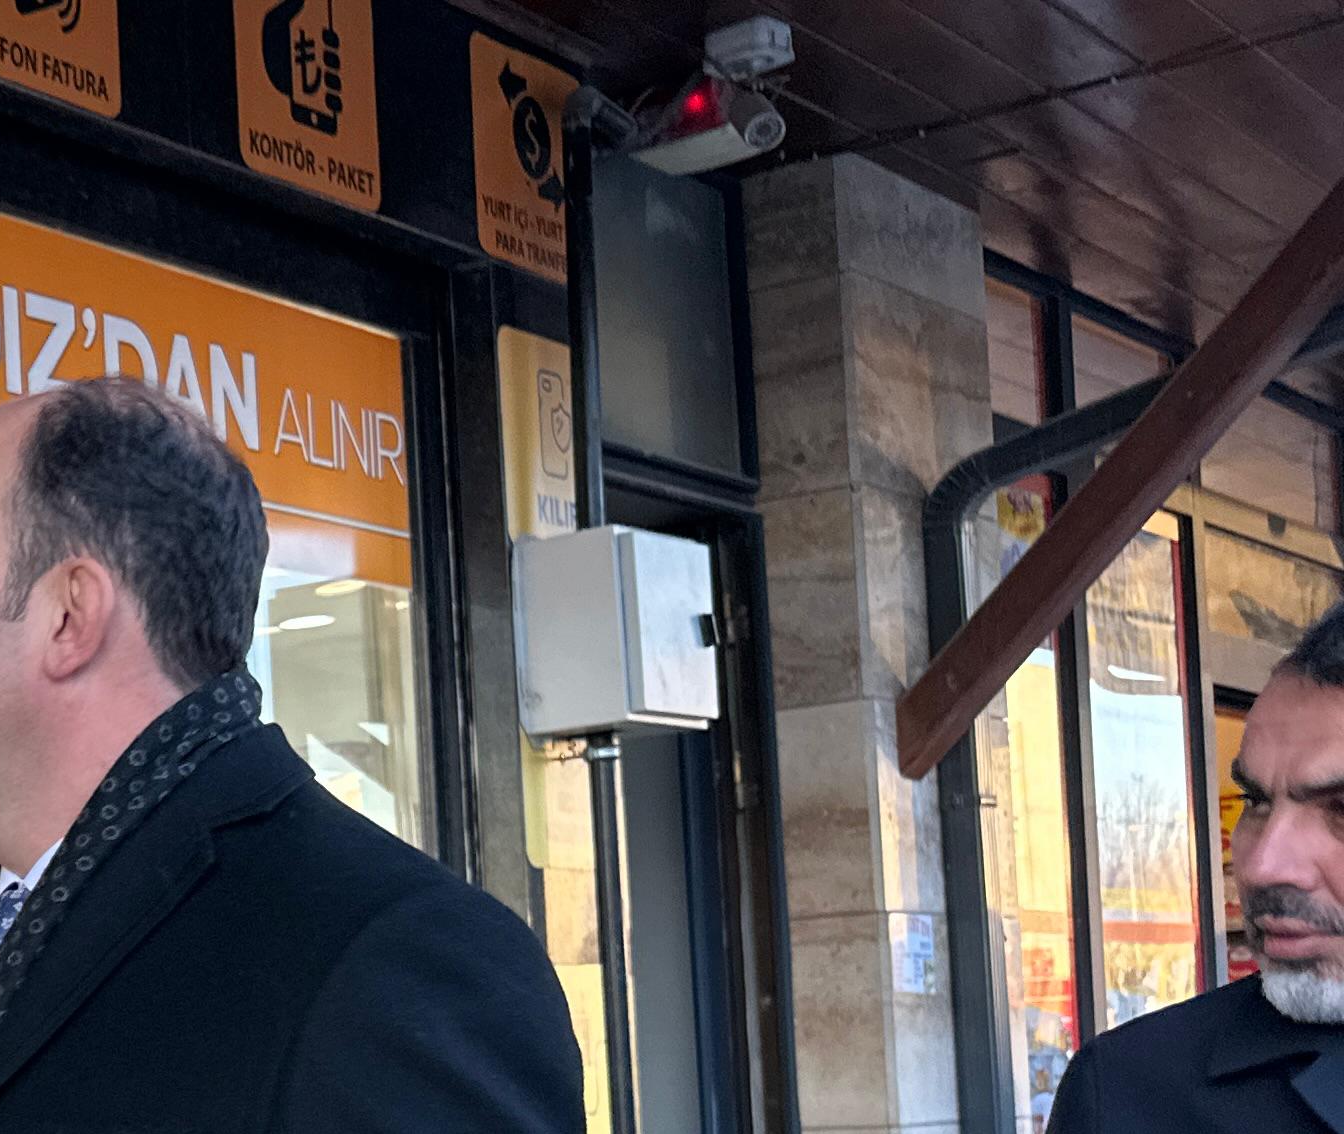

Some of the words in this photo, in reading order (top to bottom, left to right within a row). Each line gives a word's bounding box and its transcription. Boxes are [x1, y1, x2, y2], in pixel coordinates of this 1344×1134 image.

[41, 52, 110, 102] FATURA
[247, 127, 317, 177] KONTÖR
[327, 156, 376, 198] PAKET
[274, 387, 408, 487] ALINIR
